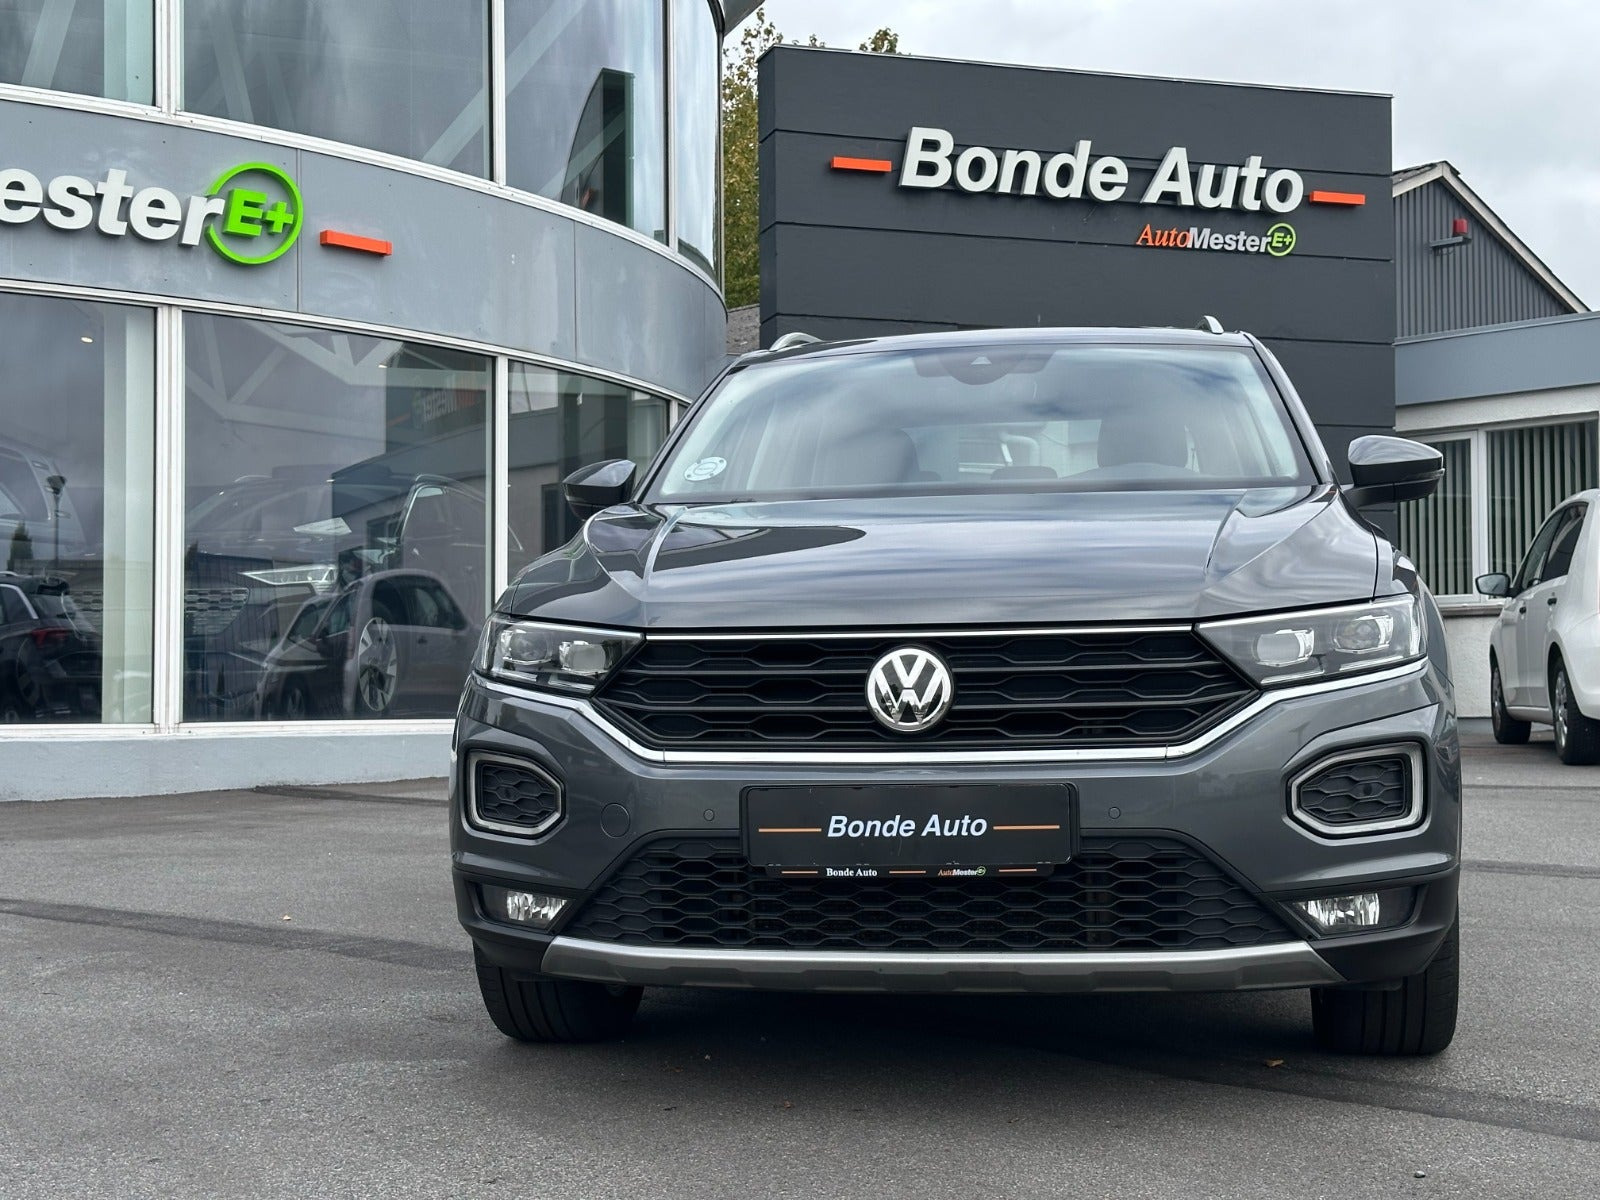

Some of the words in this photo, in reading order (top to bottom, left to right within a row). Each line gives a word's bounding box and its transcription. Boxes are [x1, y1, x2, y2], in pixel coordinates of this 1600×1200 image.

[899, 126, 1129, 202] Bonde
[1140, 146, 1304, 214] Auto
[827, 814, 916, 838] Bonde
[921, 814, 988, 837] Auto
[826, 867, 855, 877] Bonde
[856, 867, 878, 877] Auto
